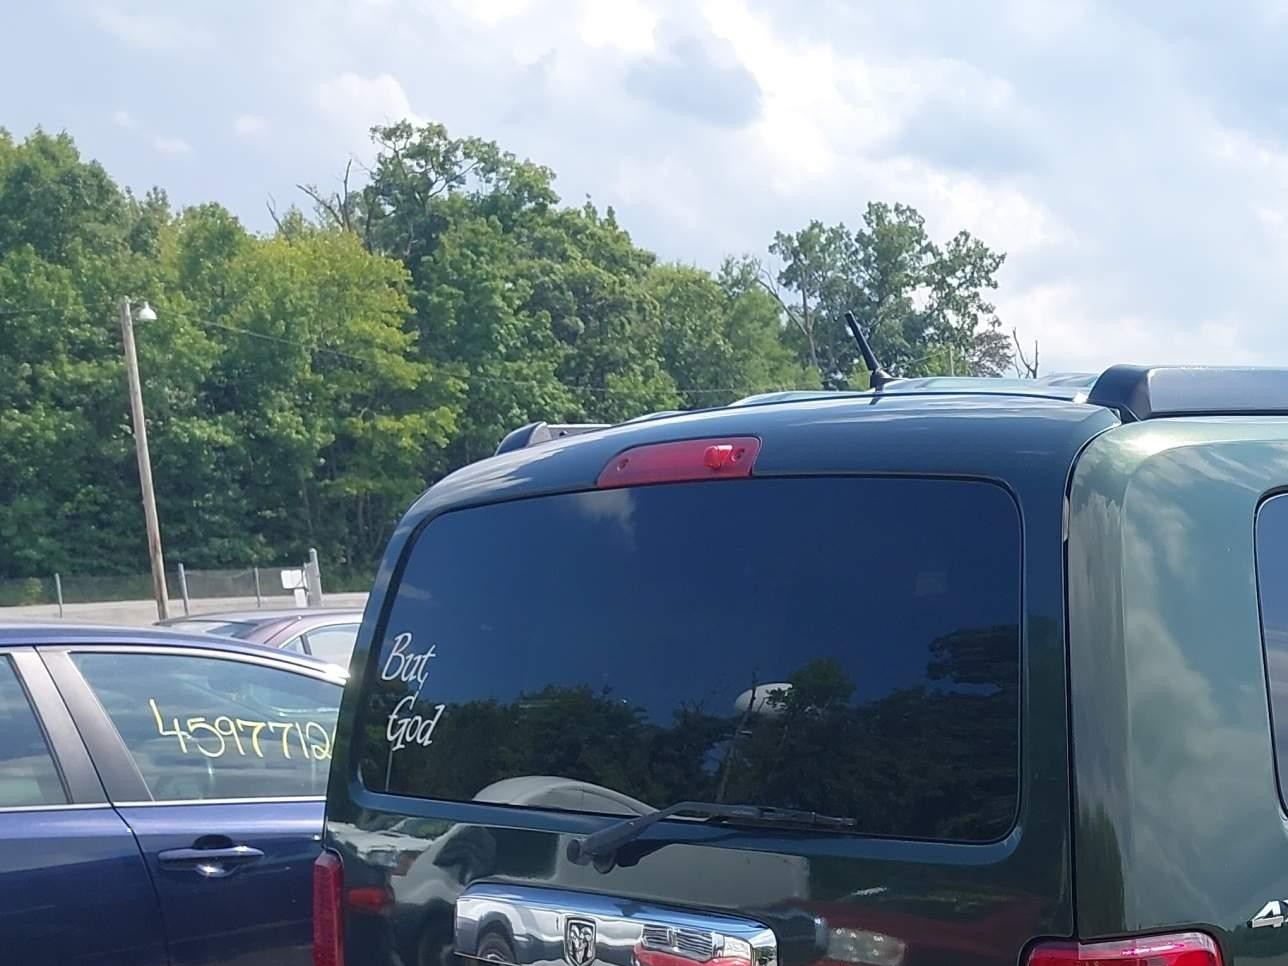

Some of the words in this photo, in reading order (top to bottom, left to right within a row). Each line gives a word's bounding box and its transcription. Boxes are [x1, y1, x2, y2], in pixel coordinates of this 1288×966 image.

[381, 632, 436, 690] But
[149, 698, 338, 760] 4597712
[386, 690, 446, 751] God
